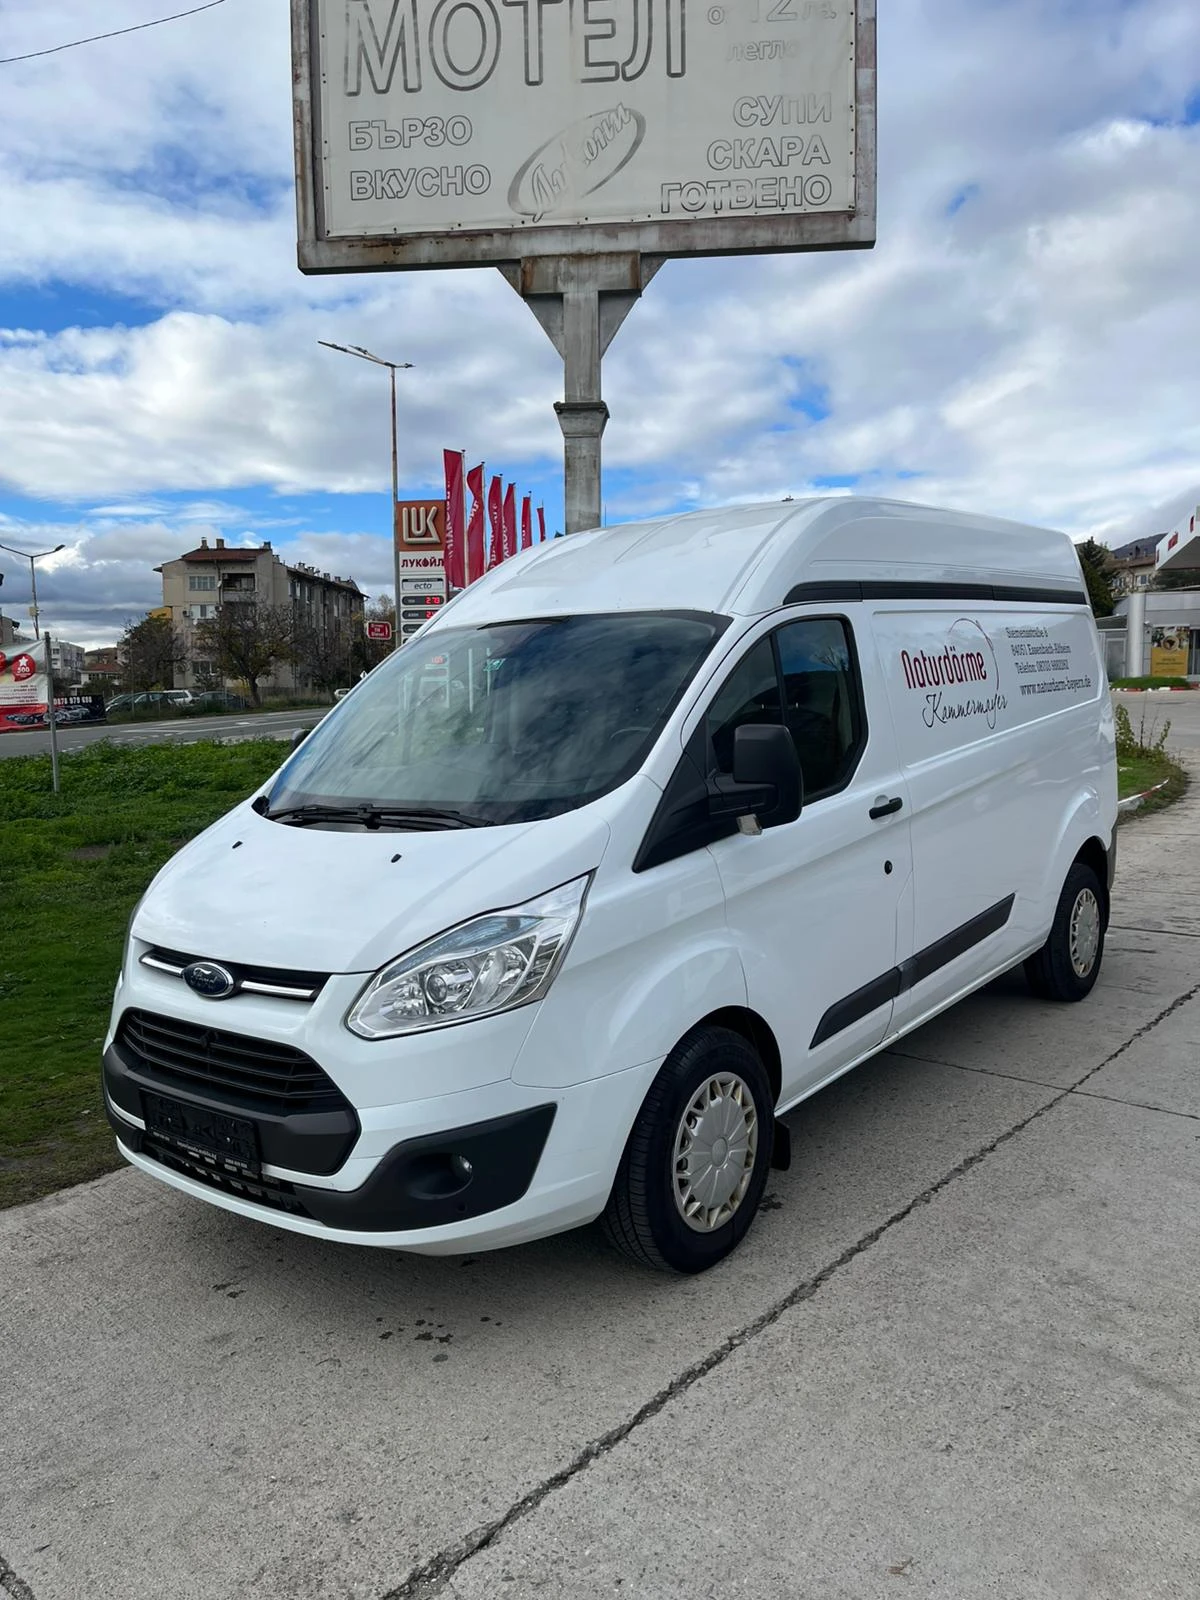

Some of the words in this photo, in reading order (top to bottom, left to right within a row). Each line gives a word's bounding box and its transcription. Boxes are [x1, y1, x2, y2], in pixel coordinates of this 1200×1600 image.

[344, 0, 687, 97] МОТЕЛ
[732, 92, 832, 128] СУПИ
[348, 114, 473, 151] БЪРЗО
[706, 134, 831, 171] СКАРА
[350, 163, 492, 201] ВКУСНО
[660, 174, 832, 213] ГОТВЕНО
[414, 582, 432, 590] ecto
[901, 645, 987, 689] Naturdärme
